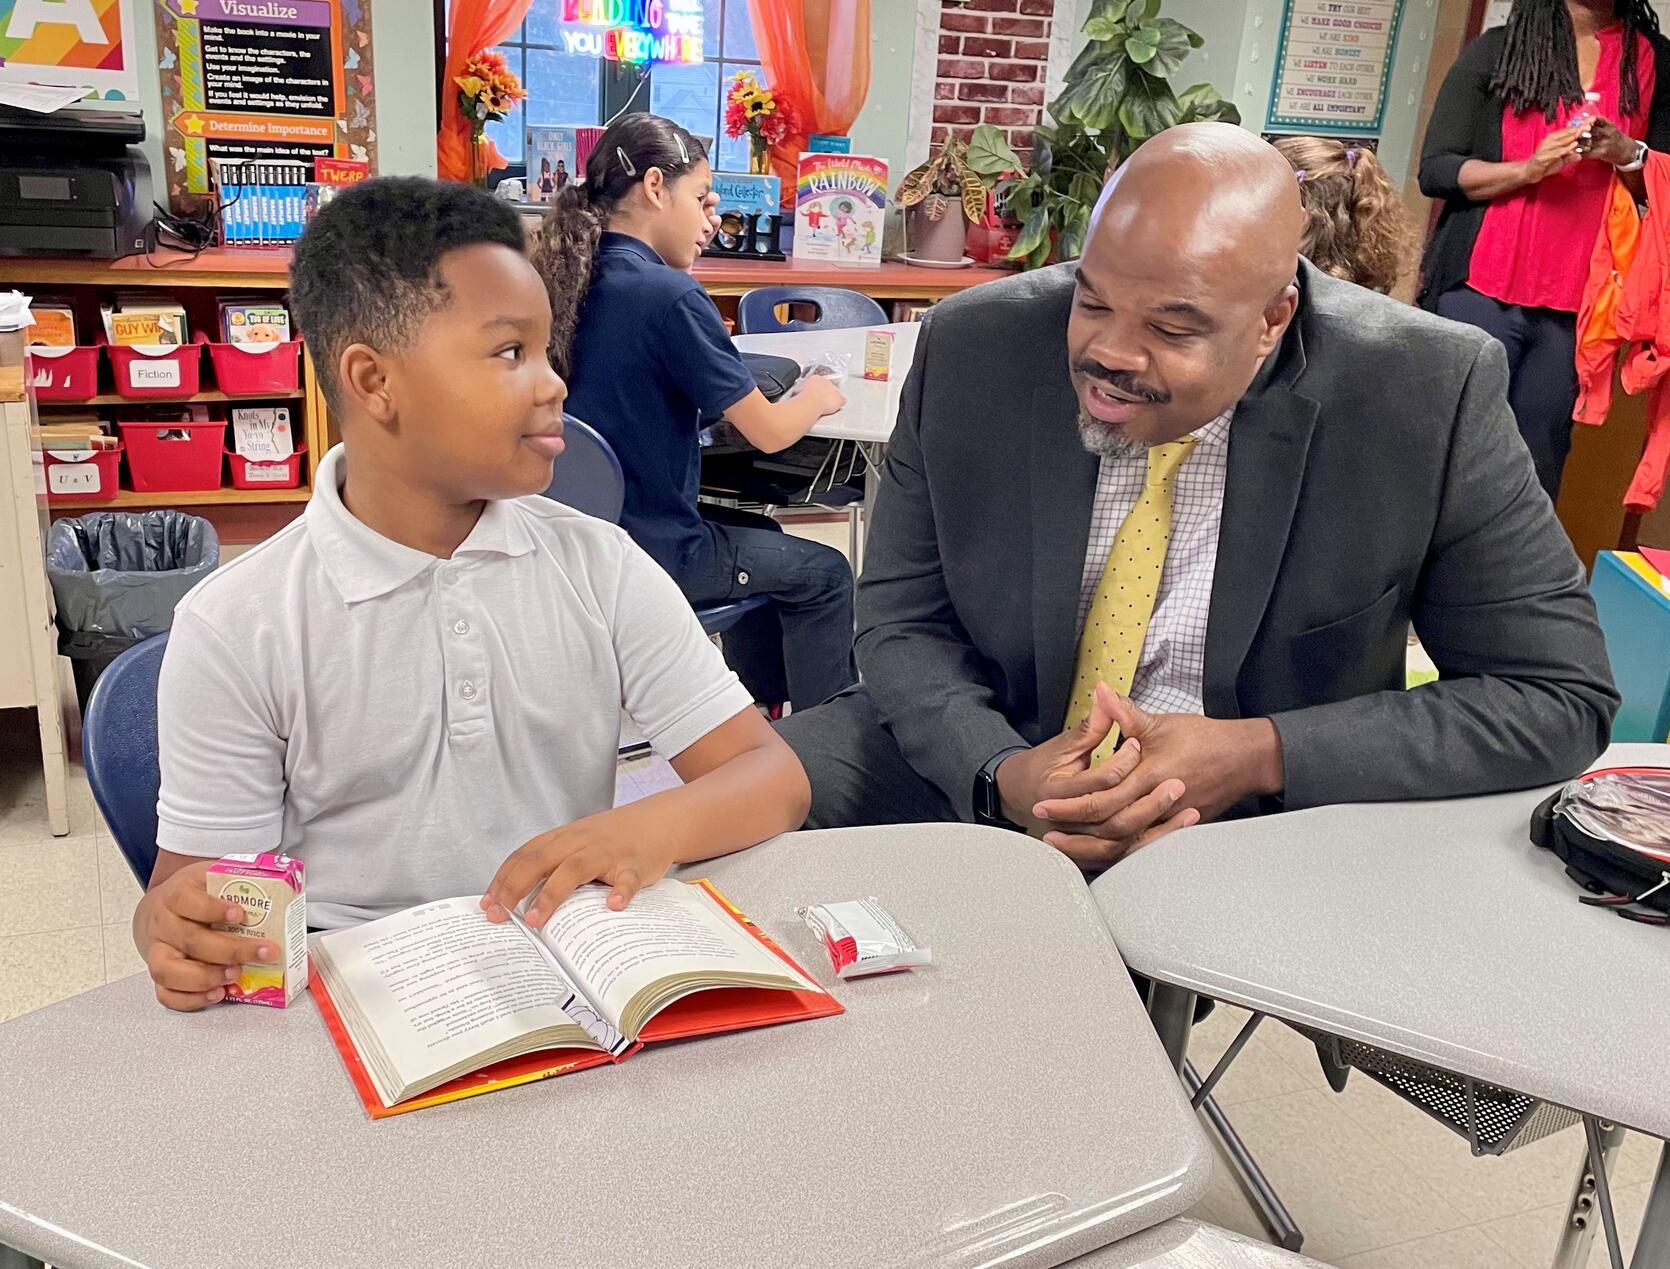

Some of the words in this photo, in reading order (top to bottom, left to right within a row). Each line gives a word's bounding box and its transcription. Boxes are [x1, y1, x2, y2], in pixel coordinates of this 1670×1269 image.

[220, 0, 298, 19] Visualize
[1311, 17, 1330, 26] MAKE
[1332, 19, 1352, 28] GOOD
[1354, 20, 1382, 31] CHOICES
[203, 25, 223, 34] Make
[237, 28, 254, 36] book
[228, 46, 246, 54] know
[563, 31, 603, 55] YOU
[605, 29, 704, 63] EVERYWHERE
[1303, 60, 1328, 69] LISTEN
[207, 73, 231, 81] Create
[242, 75, 263, 83] image
[286, 78, 321, 86] characters
[224, 81, 243, 89] mind.
[1316, 75, 1337, 84] WORK
[1338, 77, 1358, 86] HARD
[1296, 88, 1336, 98] ENCOURAGE
[285, 101, 299, 109] they
[1312, 104, 1324, 112] ALL
[1327, 104, 1367, 114] IMPORTANT
[210, 120, 265, 134] Determine
[269, 123, 328, 137] Importance
[209, 144, 228, 152] What
[275, 147, 290, 155] idea
[320, 169, 364, 182] TWERP
[808, 170, 881, 197] RAINBOW
[116, 323, 139, 336] GUY
[138, 369, 172, 380] Fiction
[237, 410, 258, 420] Knots
[60, 475, 68, 483] U
[86, 474, 93, 482] V
[220, 894, 270, 911] RDMORE
[246, 929, 265, 939] JUICE
